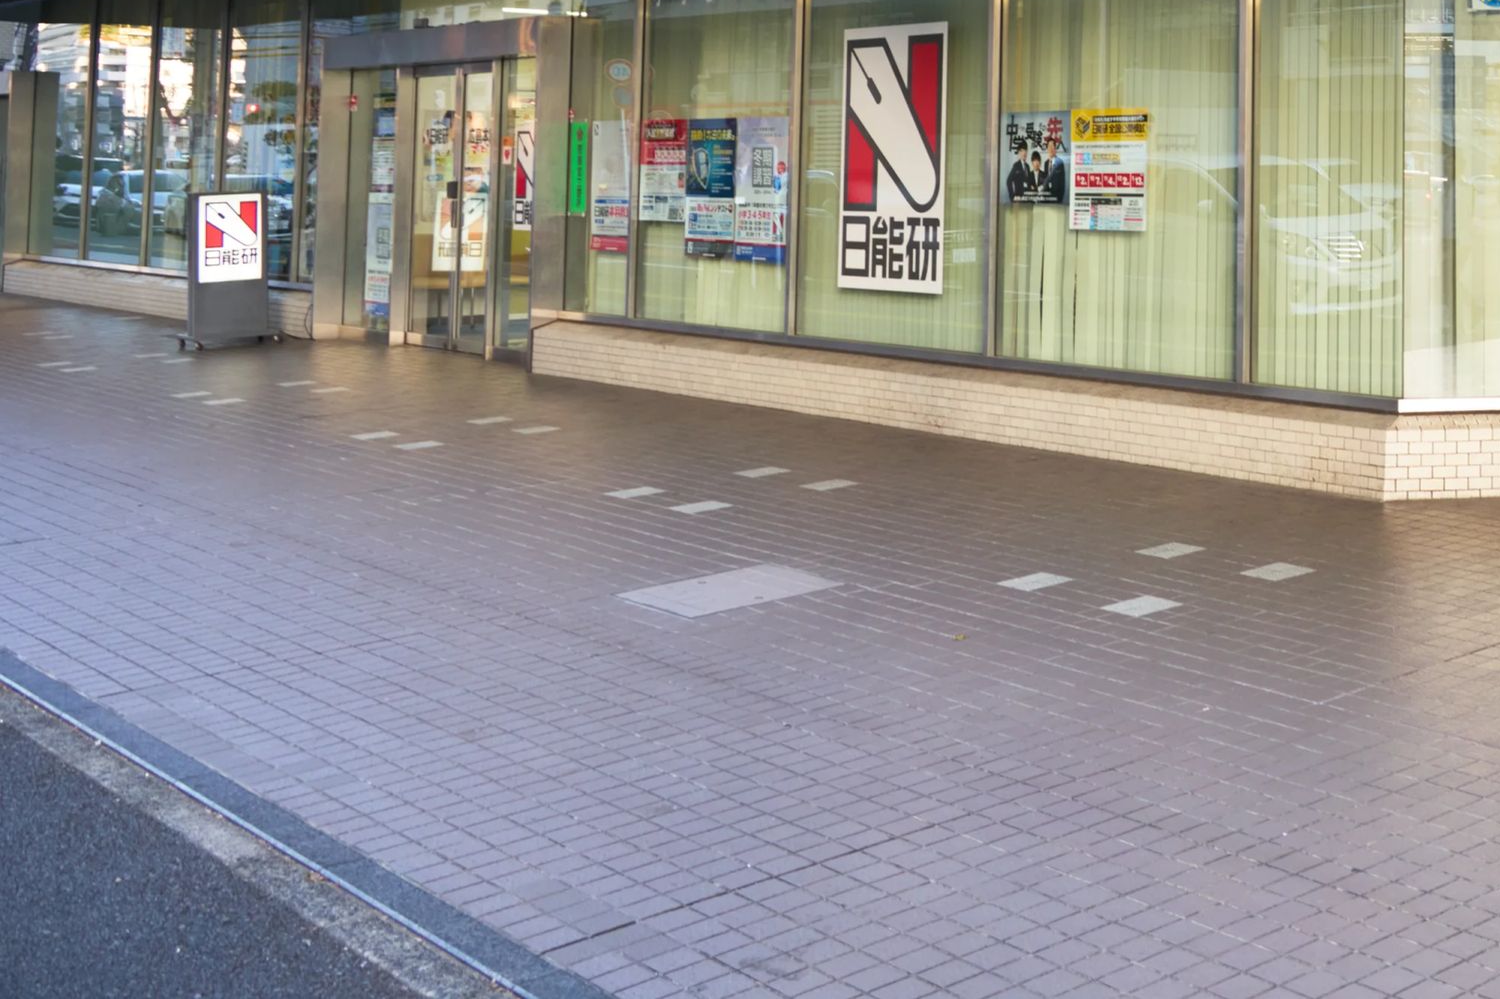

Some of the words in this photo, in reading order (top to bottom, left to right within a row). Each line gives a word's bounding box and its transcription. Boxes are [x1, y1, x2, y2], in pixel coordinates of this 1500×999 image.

[205, 249, 258, 267] 日能研
[841, 216, 941, 281] 日能研
